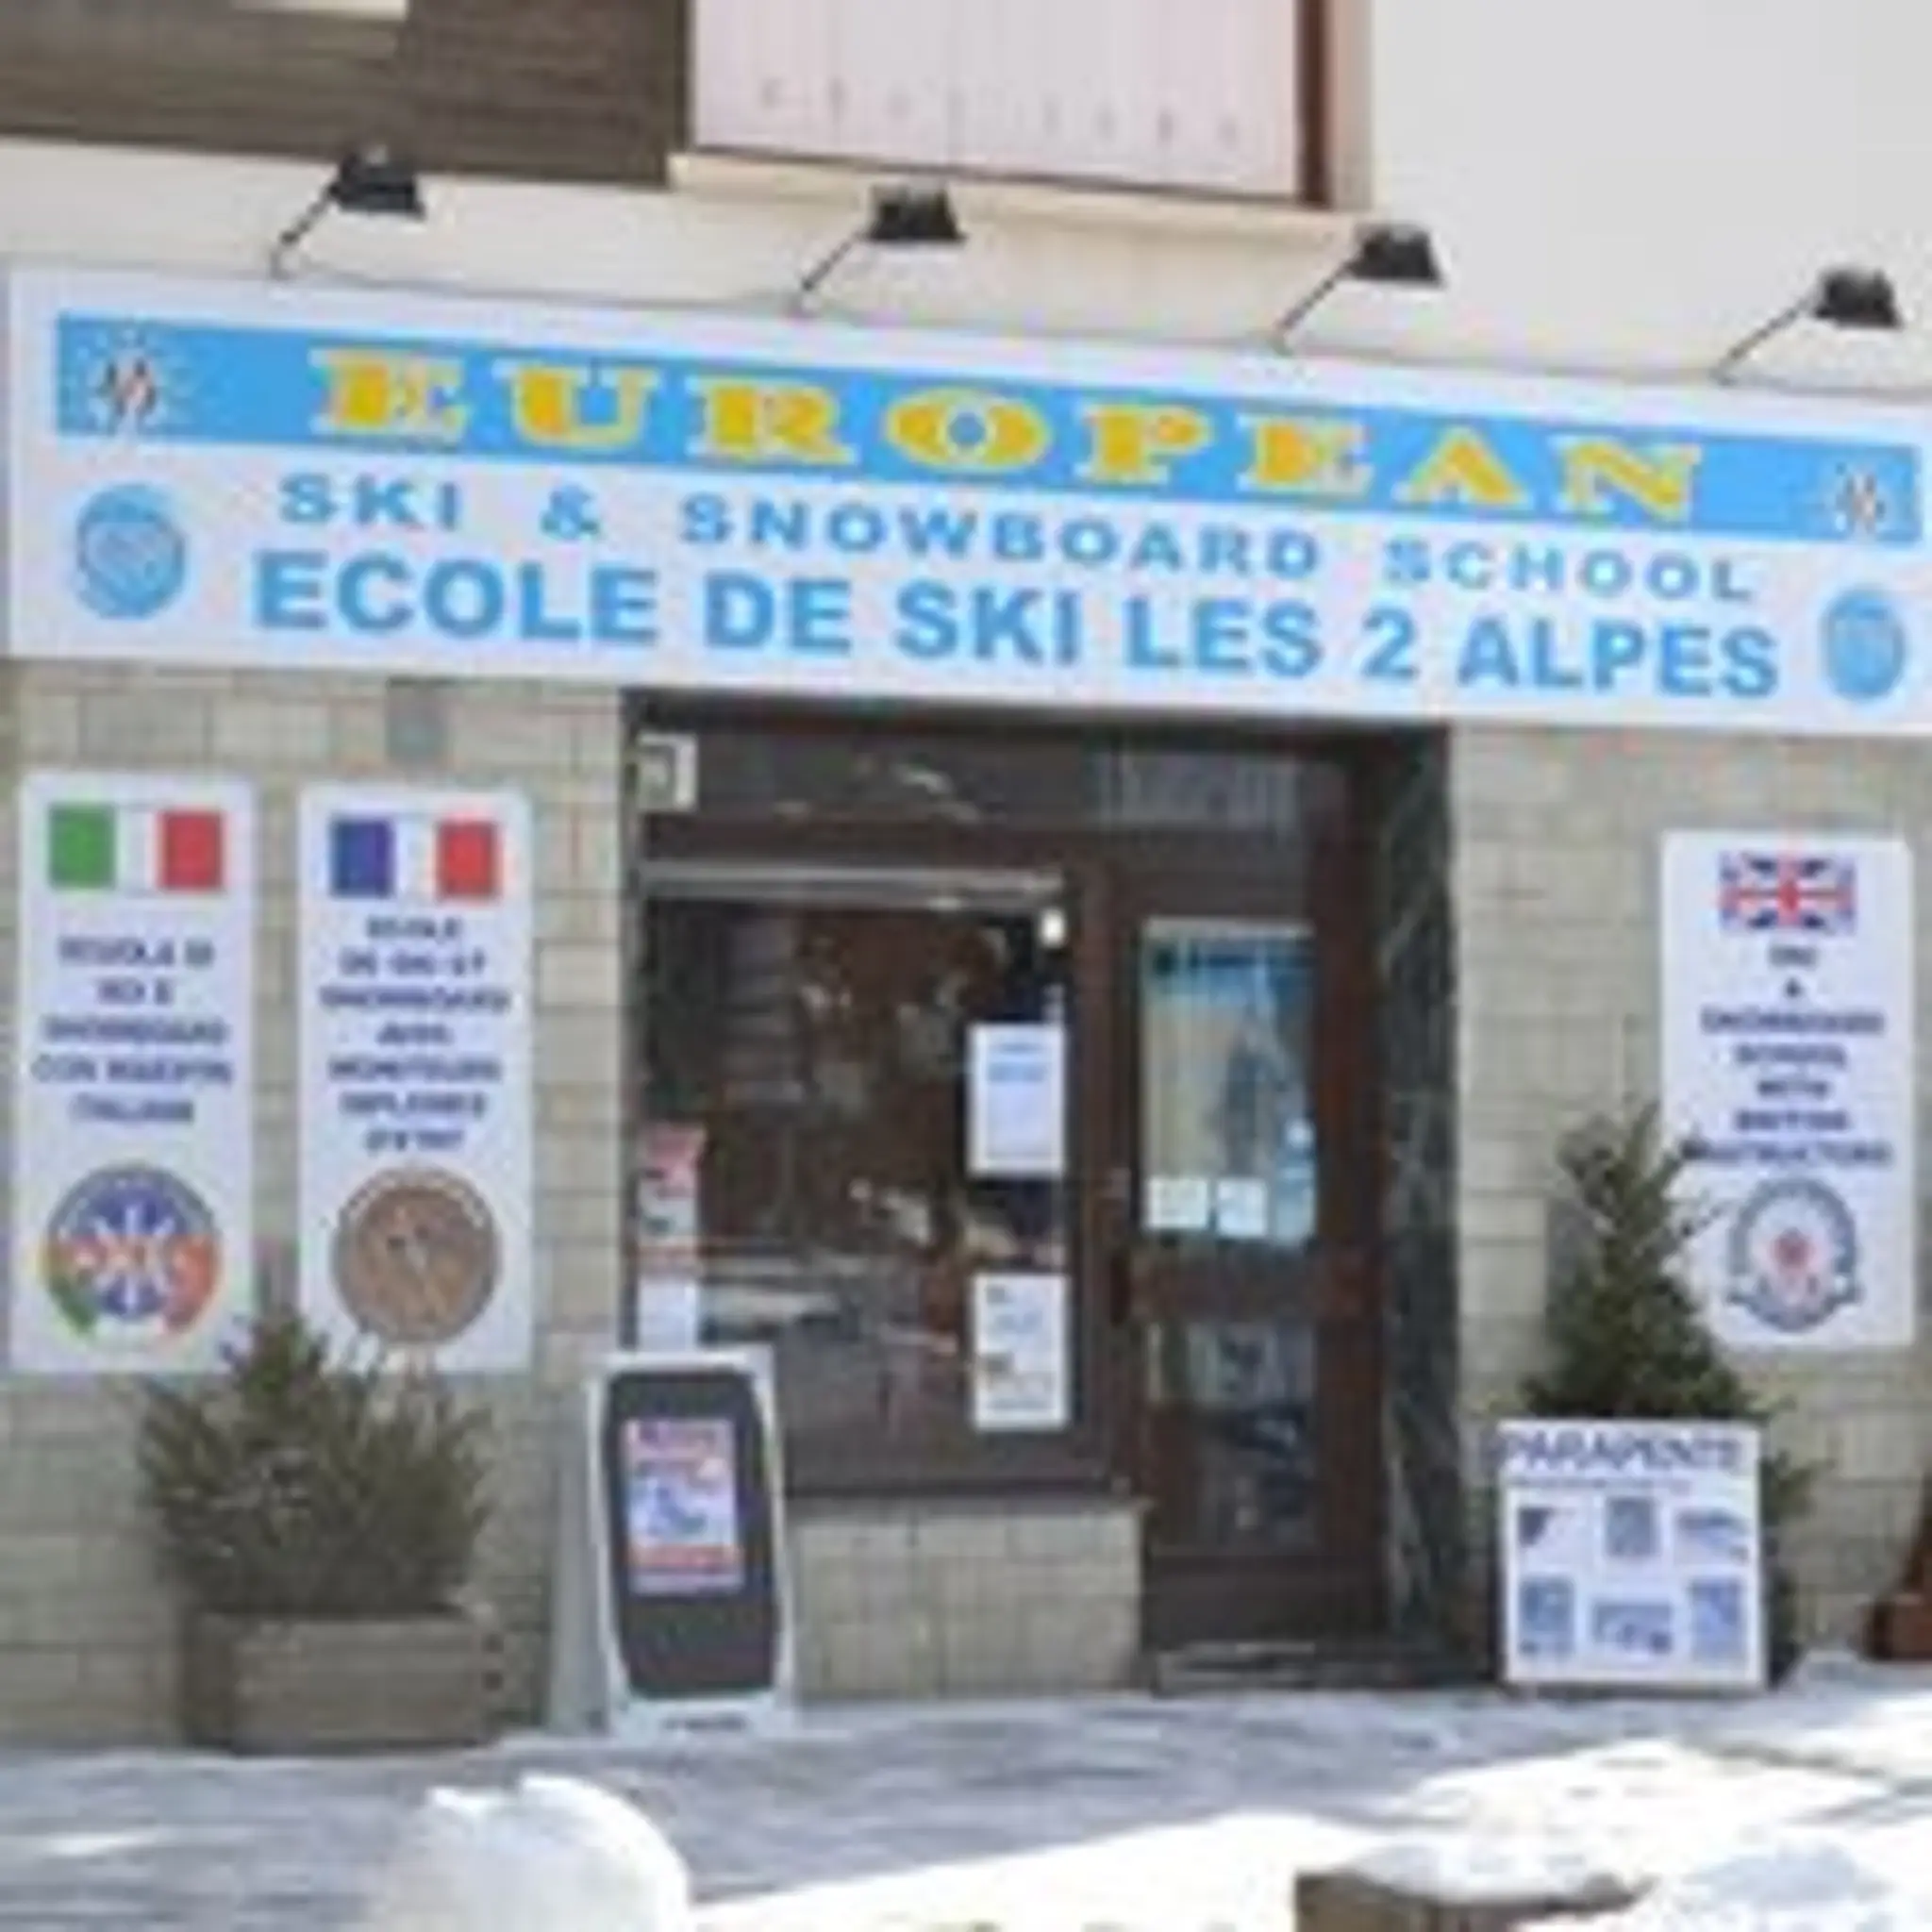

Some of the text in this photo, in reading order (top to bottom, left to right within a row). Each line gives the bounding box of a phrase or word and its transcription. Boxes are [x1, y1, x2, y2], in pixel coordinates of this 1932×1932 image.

[309, 345, 1704, 521] EUROPEAN
[277, 472, 1755, 604] SKI & SNOWBOARD SCHOOL
[253, 550, 658, 643] ECOLE
[703, 572, 852, 654] DE
[894, 579, 1081, 668] SKI
[1128, 594, 1321, 679] LES
[1361, 608, 1420, 683] 2
[1457, 615, 1779, 699] ALPES
[1501, 1429, 1743, 1474] PARAPENTE
